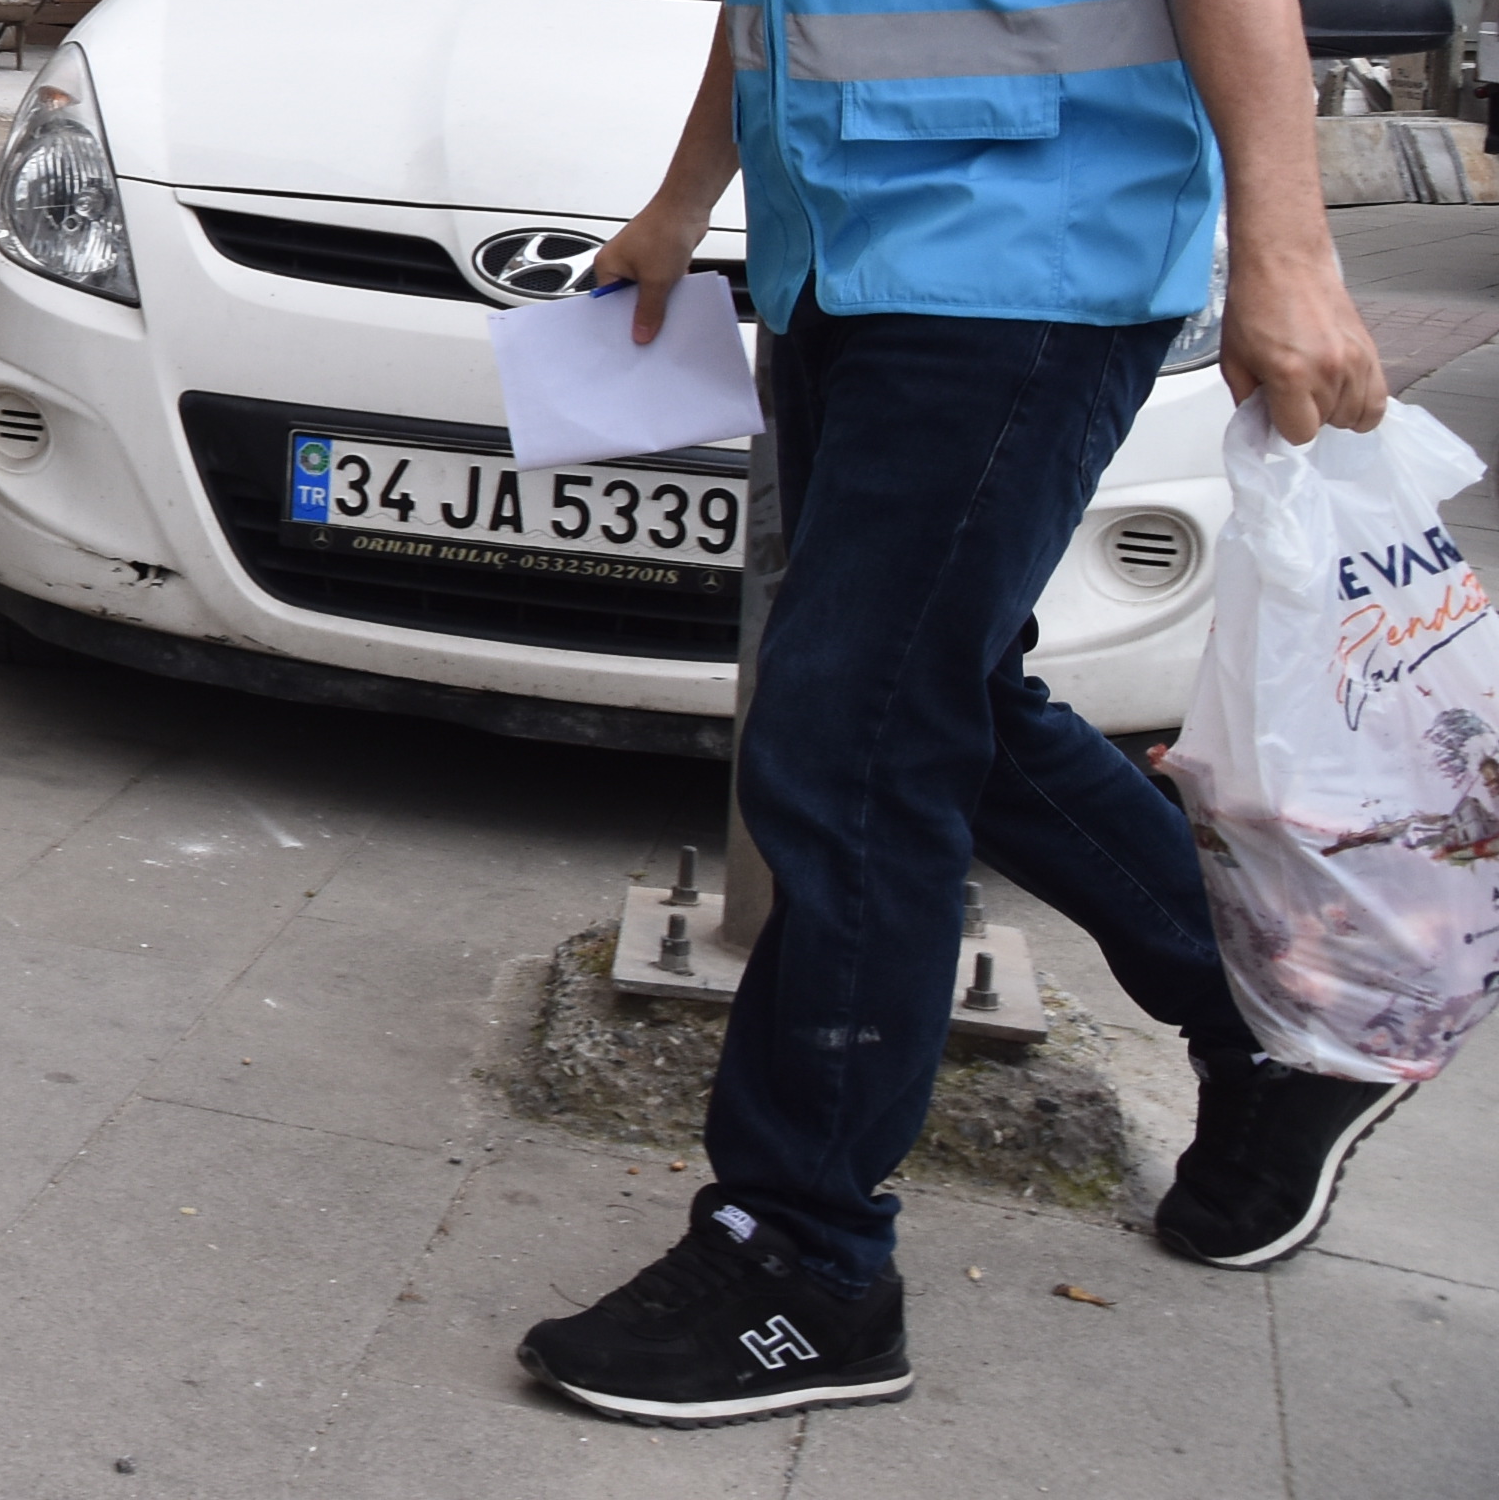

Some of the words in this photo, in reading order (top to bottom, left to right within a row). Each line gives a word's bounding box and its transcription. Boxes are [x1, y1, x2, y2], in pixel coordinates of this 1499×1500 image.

[298, 484, 327, 507] TR
[335, 454, 415, 523] 34
[440, 466, 524, 534] JA
[551, 473, 740, 554] 5339
[352, 536, 434, 558] ORHAN
